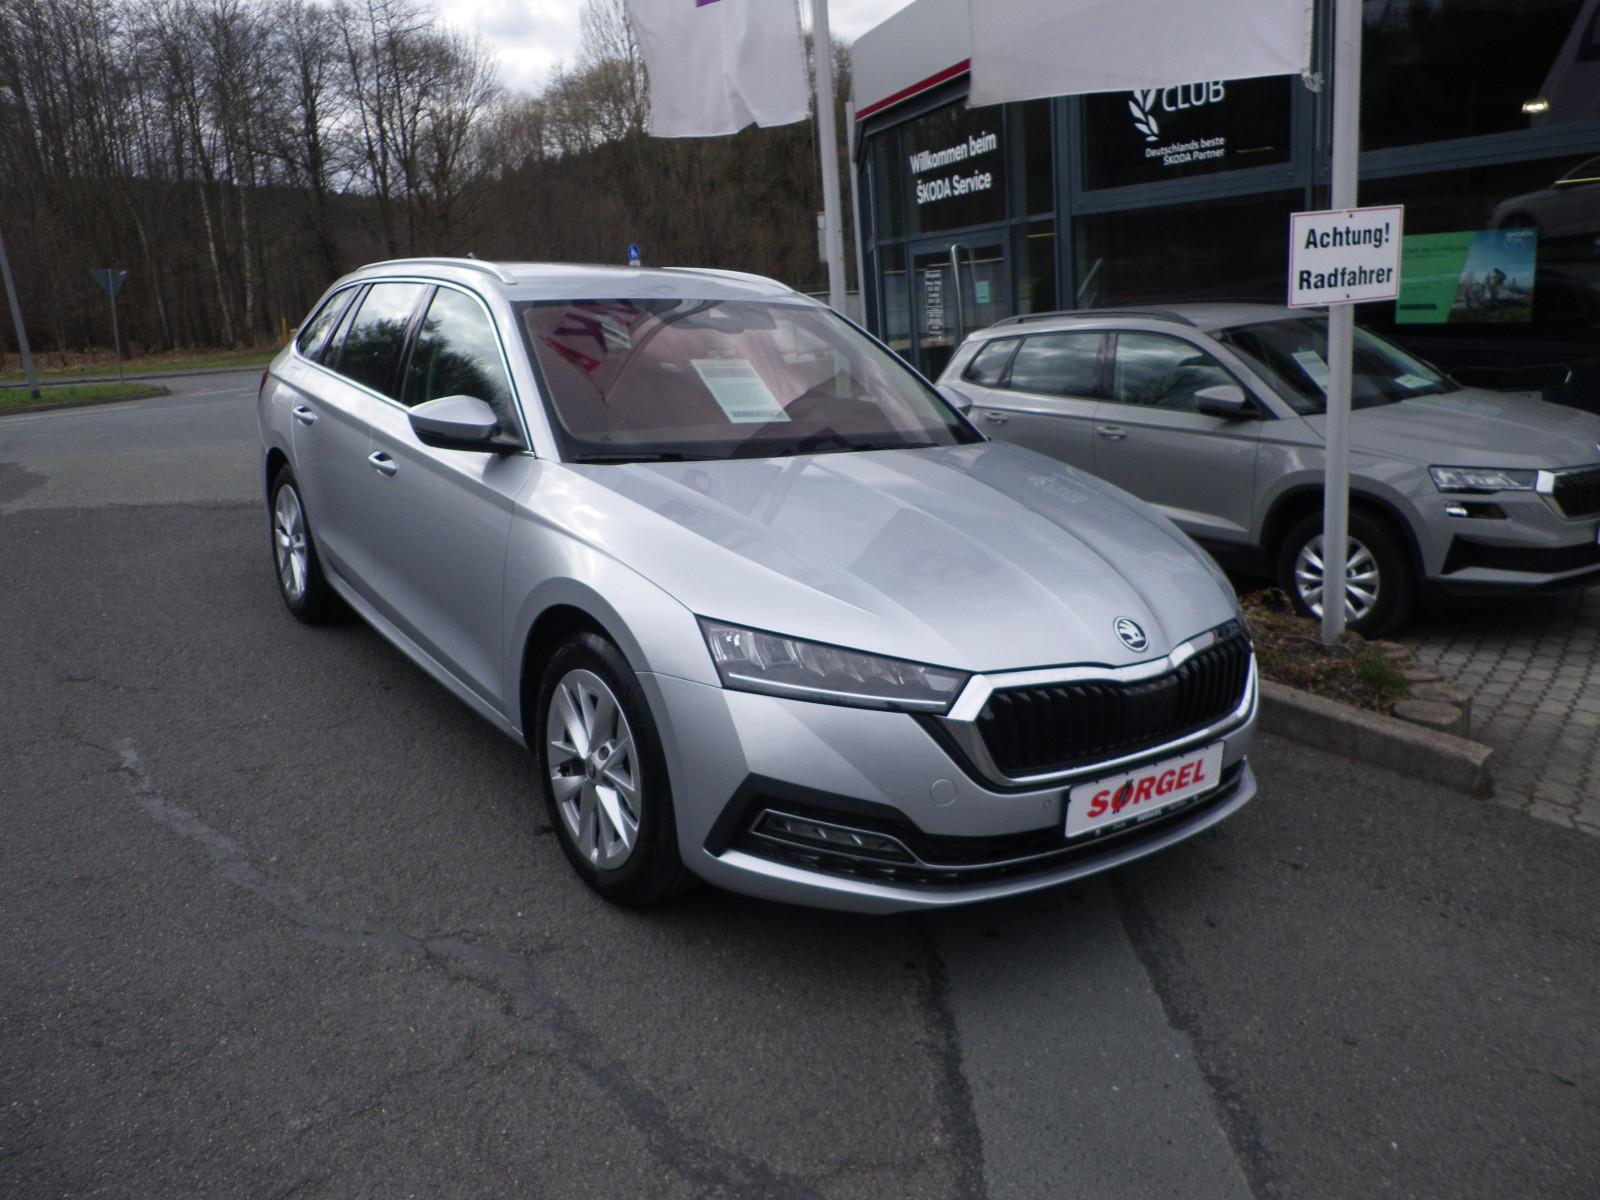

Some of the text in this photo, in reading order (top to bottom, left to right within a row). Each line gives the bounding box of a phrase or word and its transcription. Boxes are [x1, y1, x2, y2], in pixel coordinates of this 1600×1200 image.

[1162, 81, 1225, 112] CLUB
[909, 131, 997, 174] Willkommen beim
[1145, 137, 1225, 158] Deutschlands beste
[1192, 148, 1225, 160] Partner
[952, 170, 992, 196] Service
[1304, 222, 1390, 249] Achtung!
[1298, 265, 1393, 290] Radfahrer
